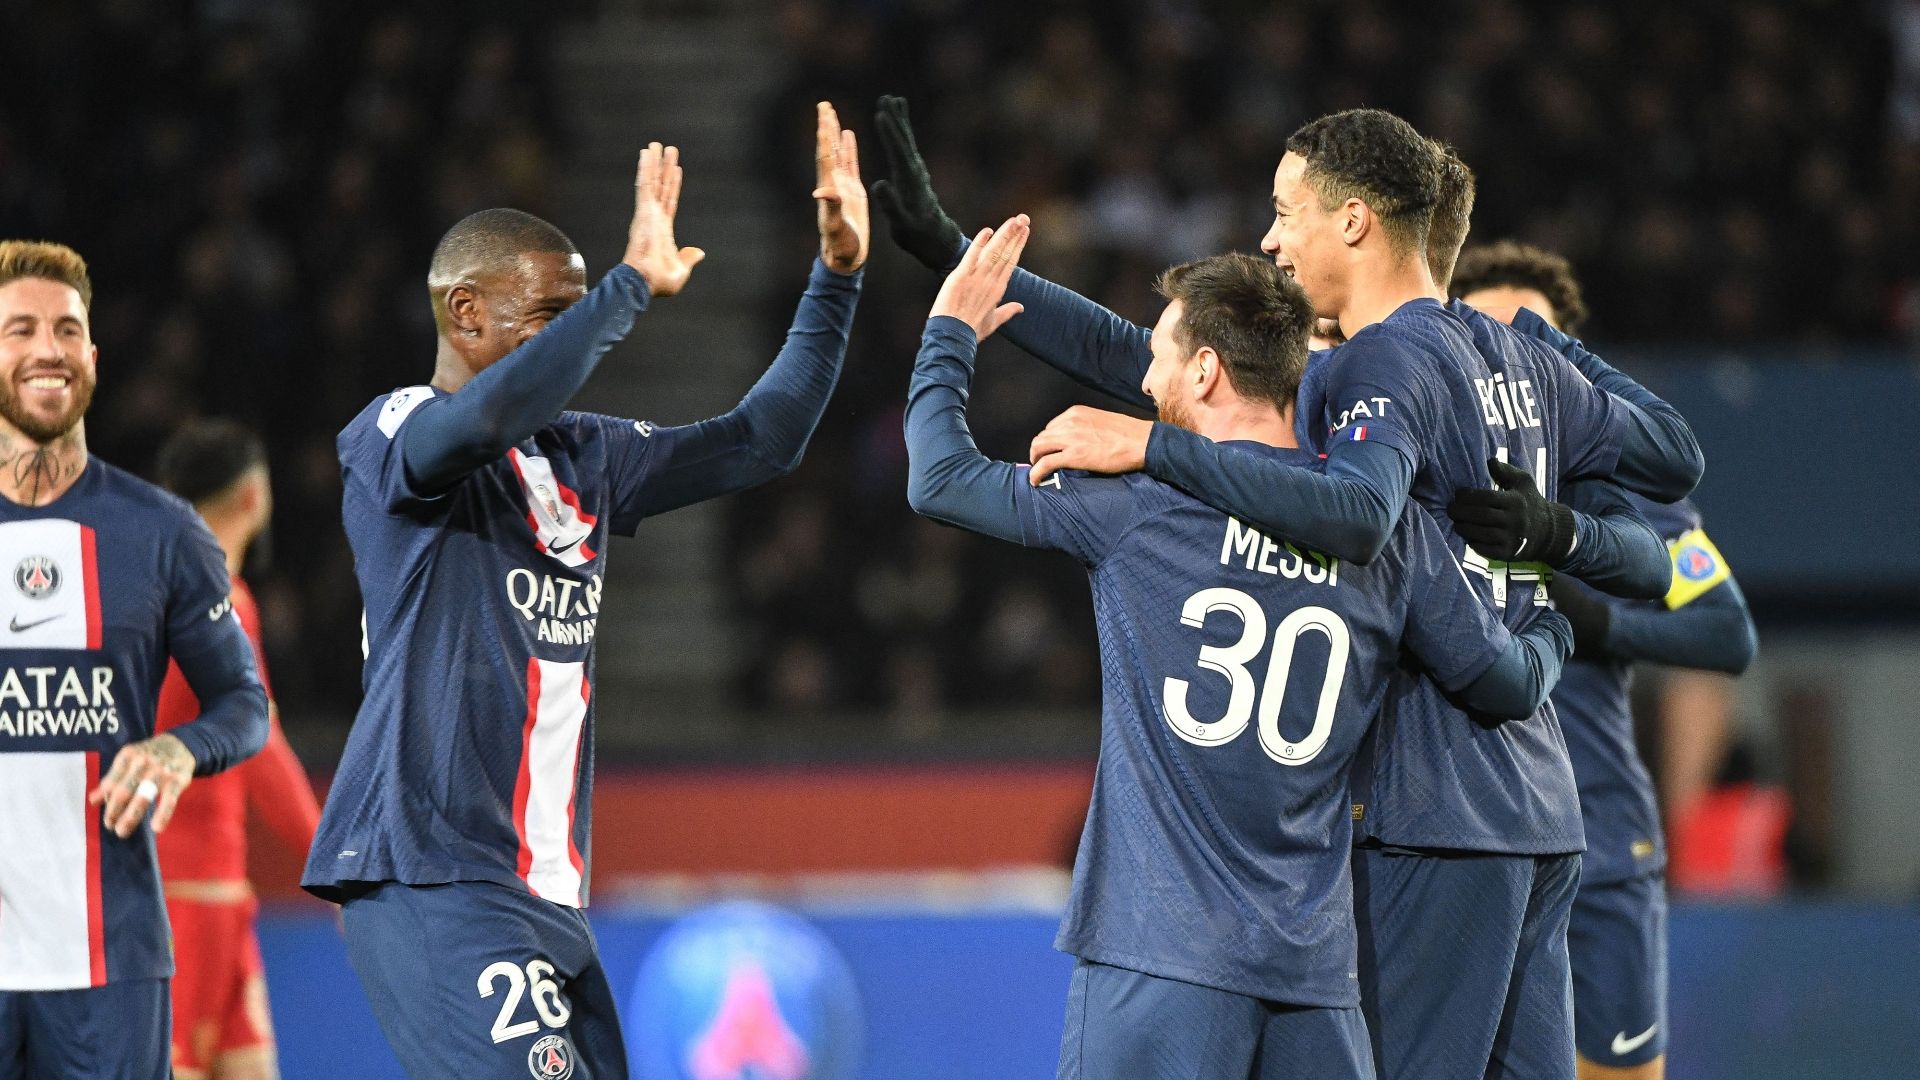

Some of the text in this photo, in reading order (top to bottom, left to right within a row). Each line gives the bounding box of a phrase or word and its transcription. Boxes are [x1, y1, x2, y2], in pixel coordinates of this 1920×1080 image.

[1220, 515, 1340, 587] MESSI
[537, 617, 597, 646] AIRWA
[0, 666, 115, 709] ATAR
[1162, 586, 1351, 767] 30
[0, 707, 119, 737] AIRWAYS
[477, 959, 571, 1044] 26
